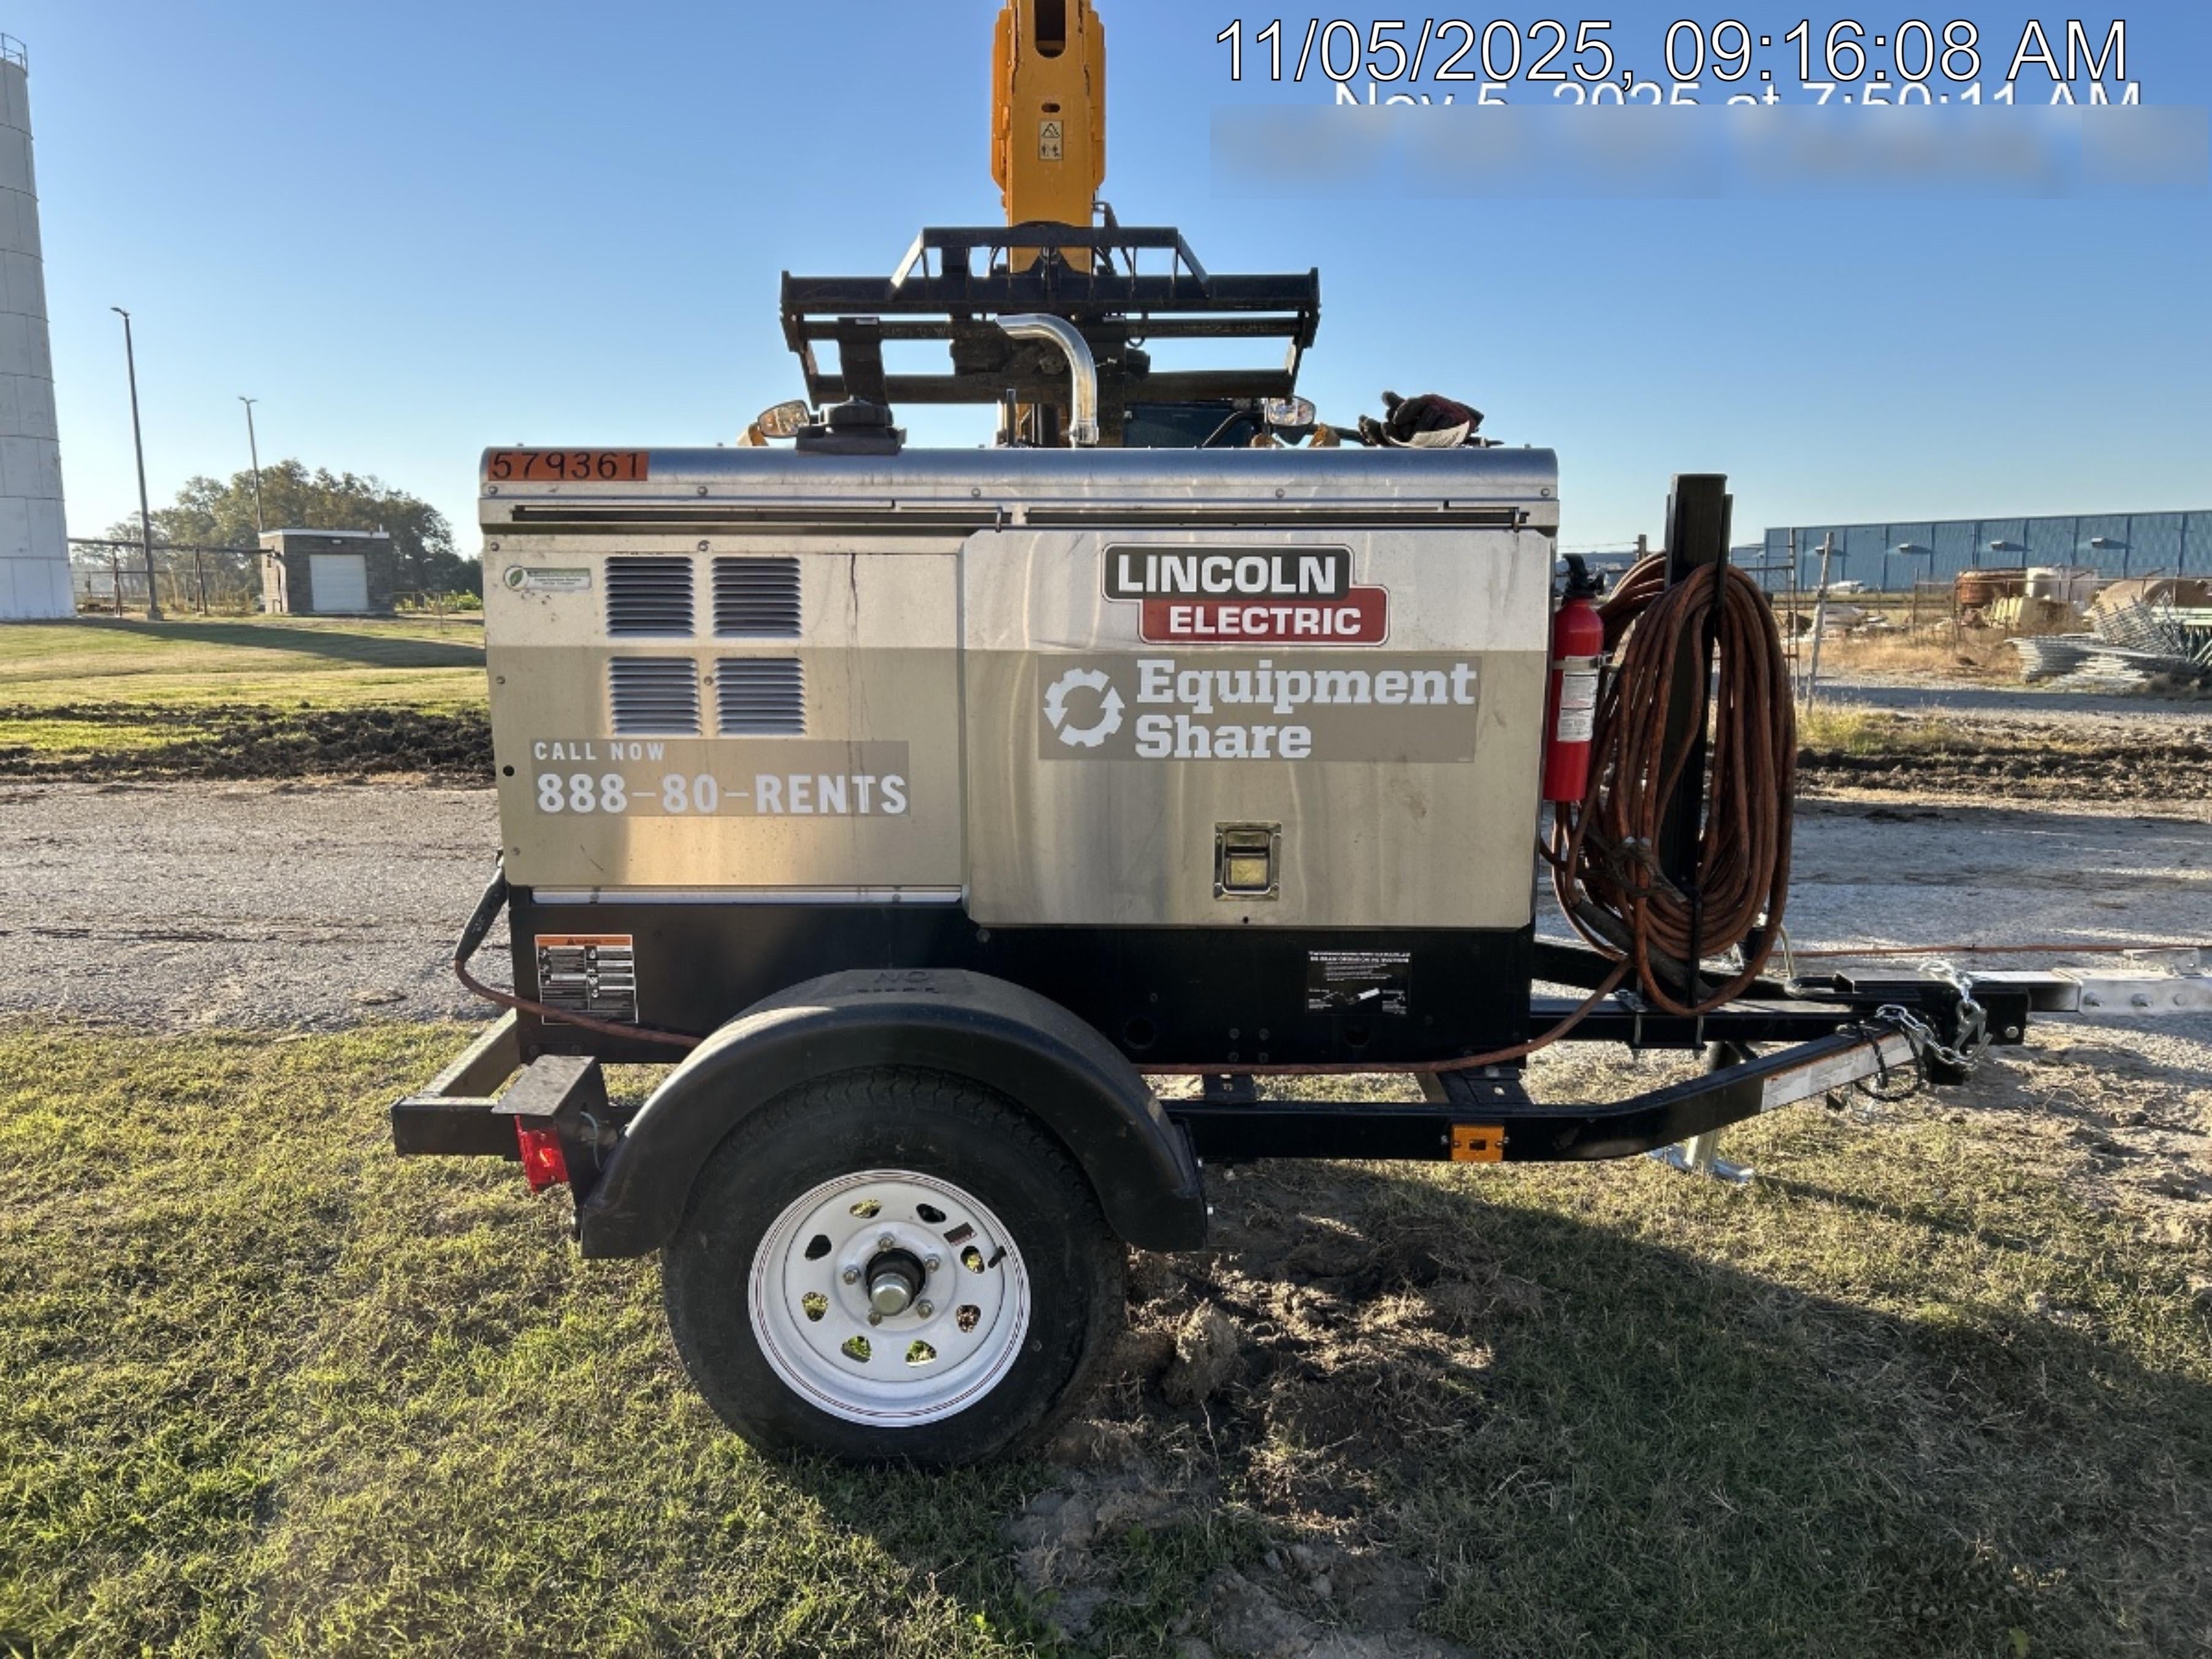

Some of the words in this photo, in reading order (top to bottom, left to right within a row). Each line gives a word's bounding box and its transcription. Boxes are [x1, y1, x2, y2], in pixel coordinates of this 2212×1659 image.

[492, 450, 638, 480] 579361
[1118, 554, 1336, 594] LINCOLN
[1169, 606, 1361, 635] ELECTRIC
[1136, 659, 1477, 714] Equipment
[534, 742, 597, 761] CALL
[611, 742, 665, 761] NOW
[1135, 715, 1312, 759] Share
[537, 772, 907, 814] 888-80-RENTS
